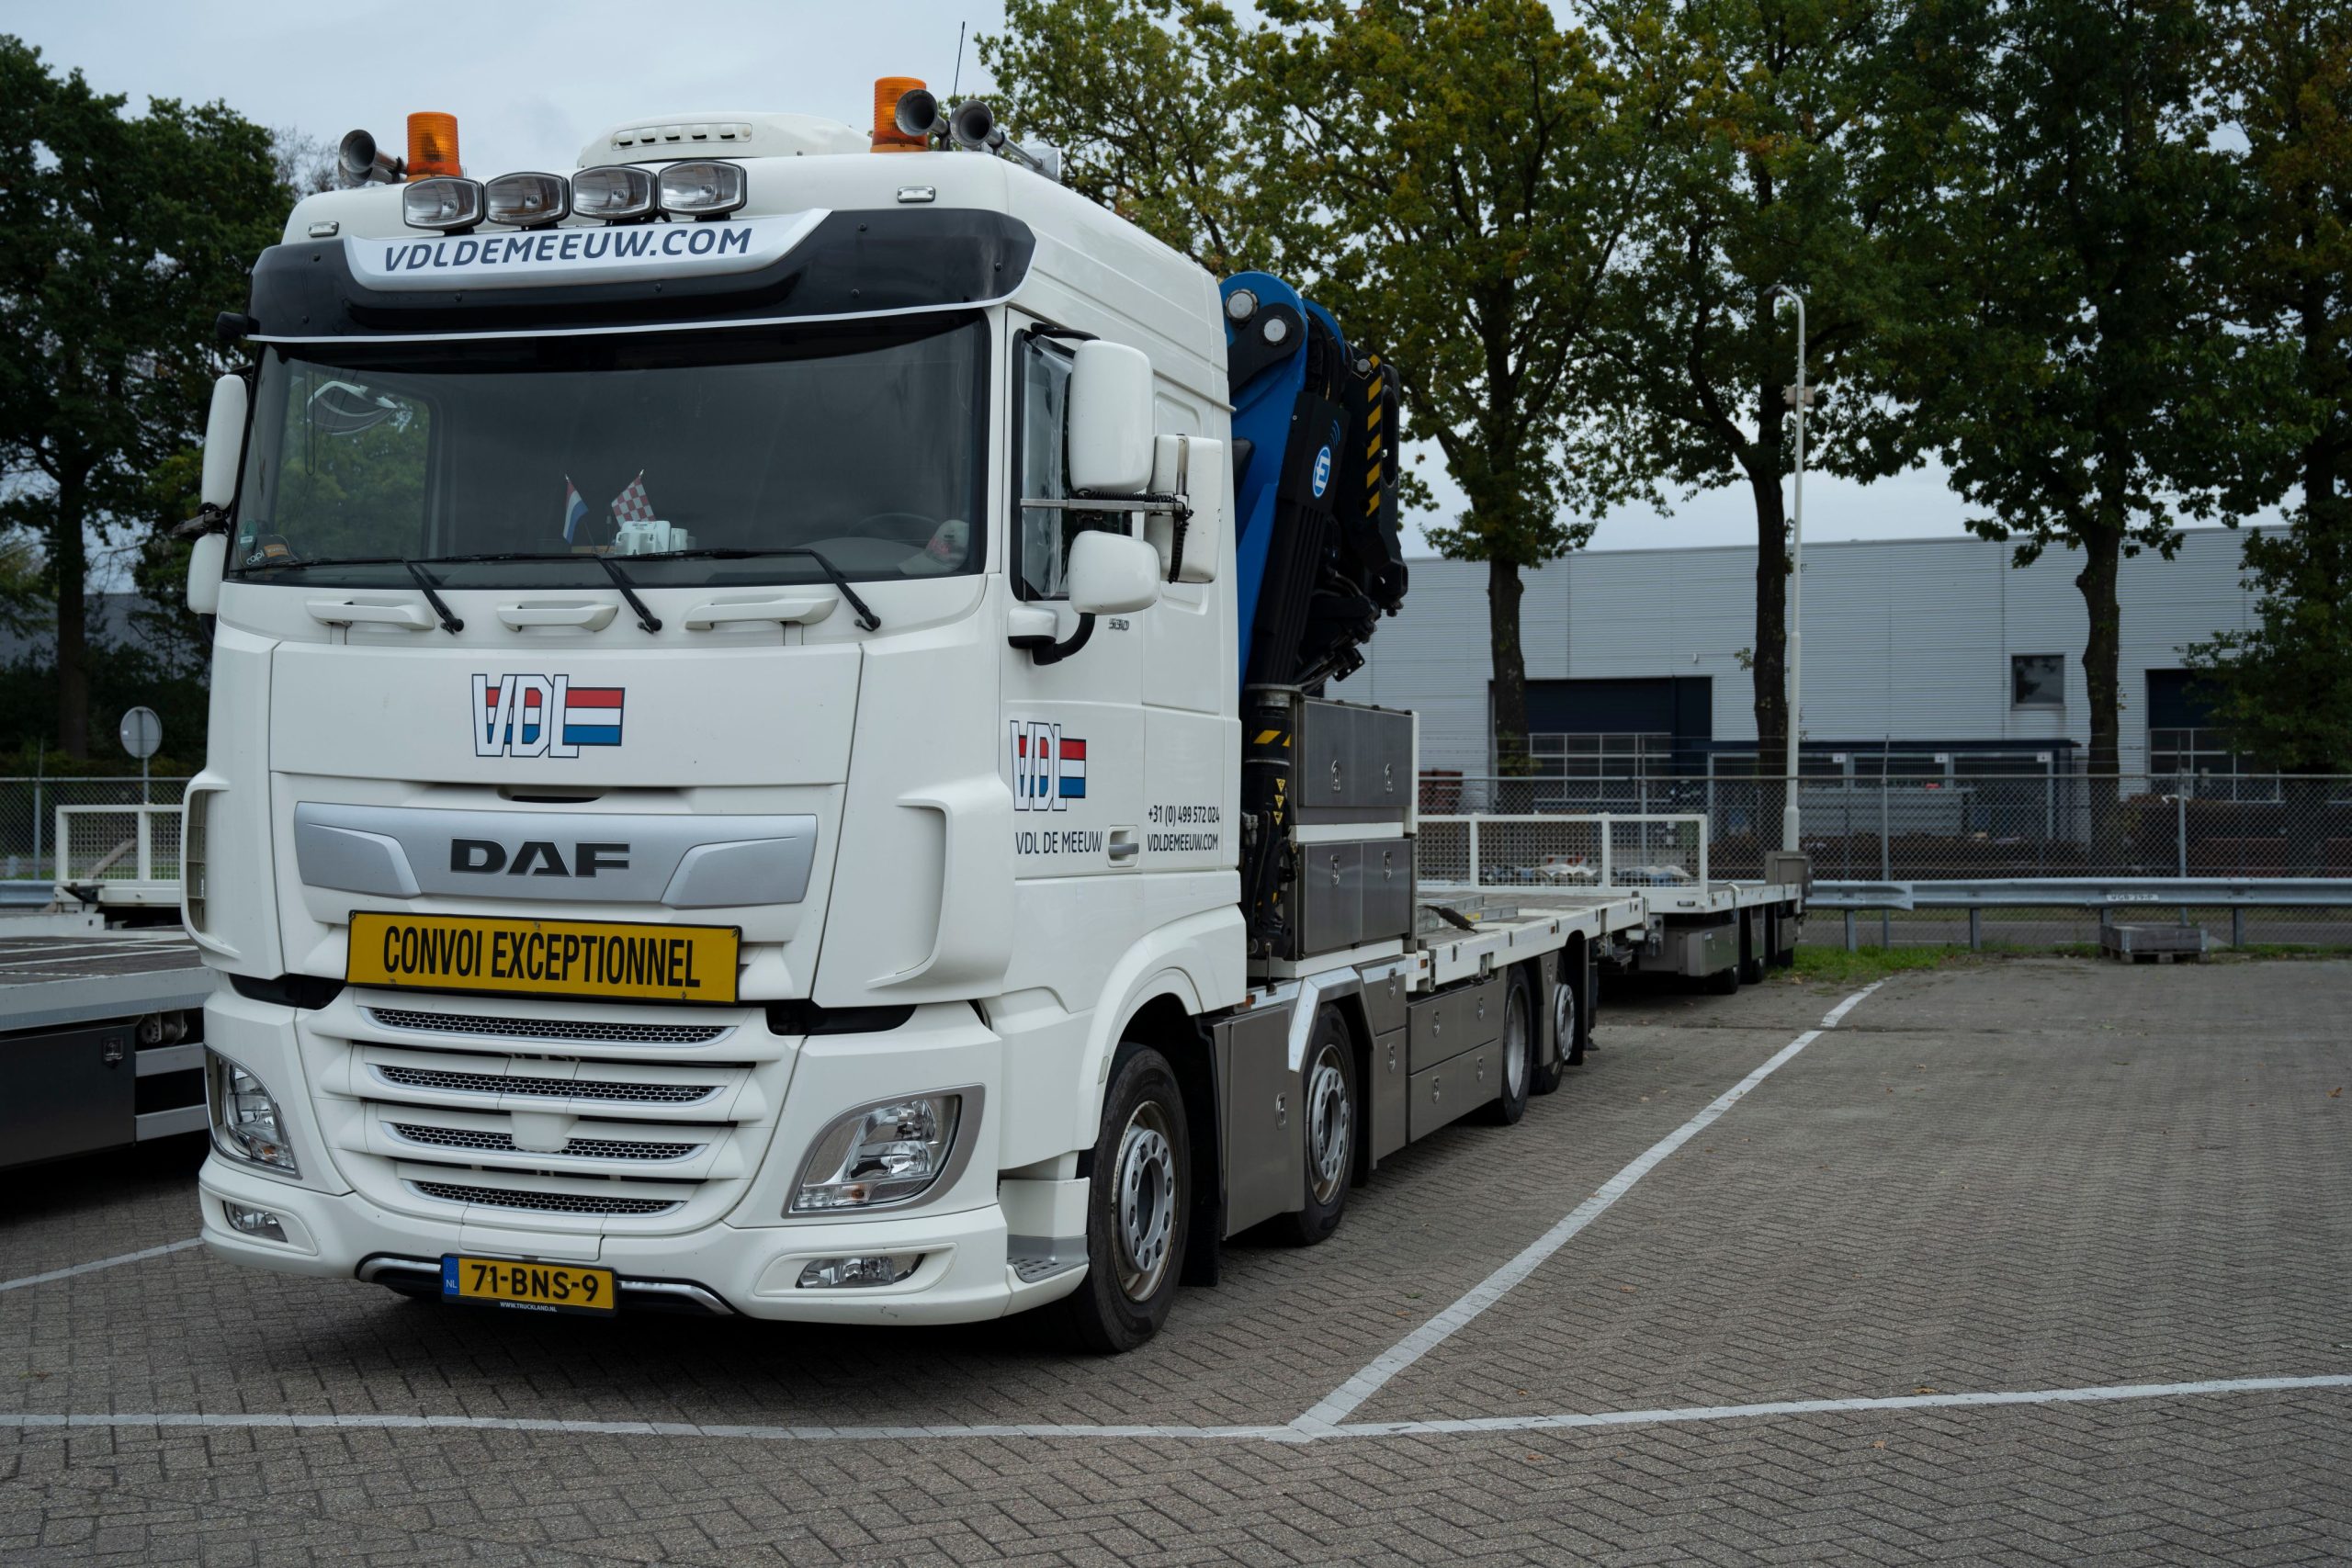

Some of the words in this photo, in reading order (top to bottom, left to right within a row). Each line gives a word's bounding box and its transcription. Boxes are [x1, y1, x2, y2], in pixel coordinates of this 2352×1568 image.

[385, 228, 752, 271] VDLDEMEEUW.COM
[471, 673, 580, 759] VDL
[1010, 720, 1068, 811] VDL
[1148, 805, 1162, 823] +31
[1165, 805, 1176, 827] (0)
[1178, 806, 1193, 823] 499
[1193, 806, 1206, 823] 572
[1207, 807, 1220, 823] 024
[450, 837, 630, 878] DAF
[1015, 831, 1040, 855] VDL
[1043, 831, 1058, 854] DE
[1061, 830, 1103, 853] MEEUW
[1147, 833, 1219, 852] VDLDEMEEUW.COM
[383, 925, 482, 977] CONVOI
[491, 930, 701, 989] EXCEPTIONNEL
[446, 1279, 458, 1289] NL
[470, 1264, 599, 1303] 71-BNS-9
[499, 1301, 558, 1314] WWW.TRUCKLAND.NL
